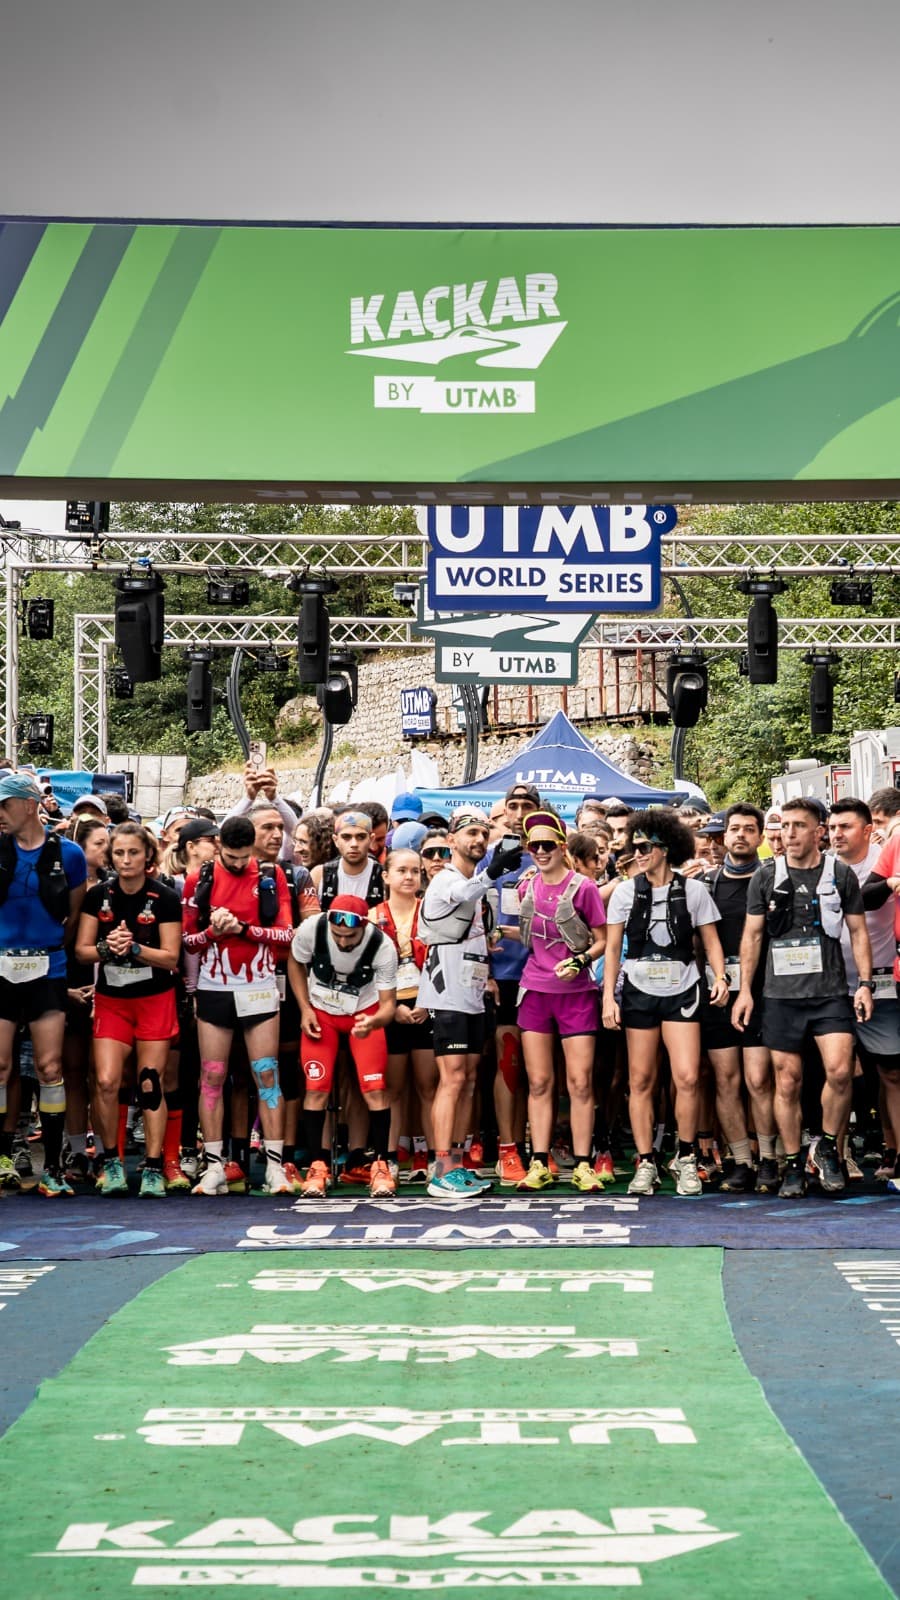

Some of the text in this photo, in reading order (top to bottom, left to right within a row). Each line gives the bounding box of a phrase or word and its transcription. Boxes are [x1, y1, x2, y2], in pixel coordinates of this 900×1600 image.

[350, 273, 560, 344] KAÇKAR
[388, 383, 517, 408] BY UTMB
[446, 566, 643, 594] WORLD SERIES
[453, 652, 556, 674] BY UTMB
[402, 690, 430, 714] UTMB
[515, 769, 597, 785] UTMB
[445, 800, 493, 808] MEET YOUR
[179, 1569, 583, 1583] BY UTMB
